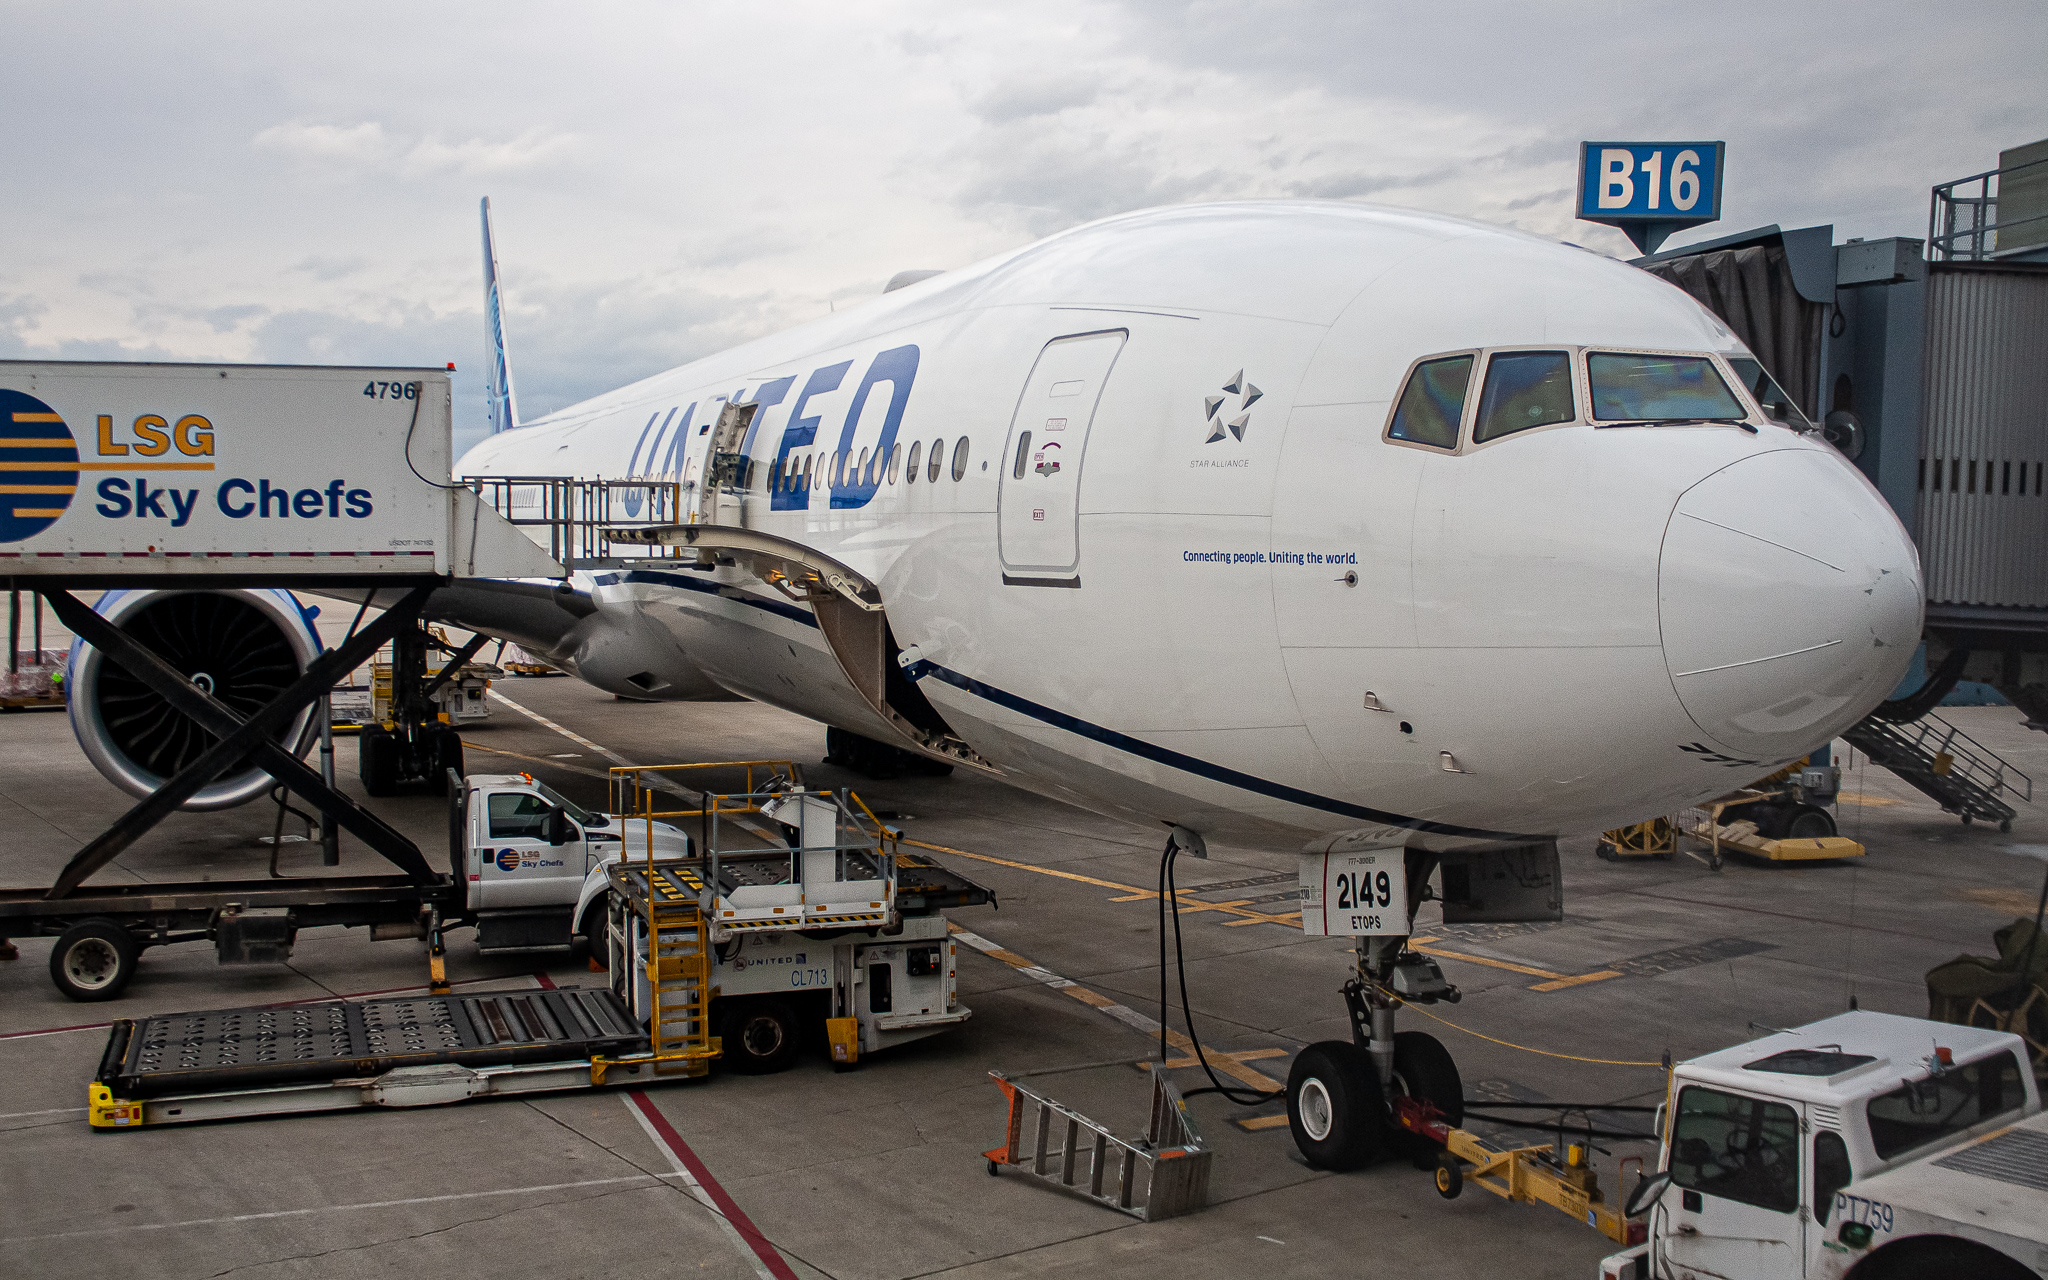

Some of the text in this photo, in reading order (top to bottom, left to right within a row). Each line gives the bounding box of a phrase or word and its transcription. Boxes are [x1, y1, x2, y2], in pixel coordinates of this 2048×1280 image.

[1598, 148, 1700, 211] B16
[363, 381, 416, 400] 4796
[97, 414, 215, 456] LSG
[624, 344, 920, 518] UNTED
[1190, 459, 1249, 468] STAR ALLIANCE
[96, 477, 374, 527] Sky Chefs
[1183, 550, 1358, 565] Connecting people. Uniting the world.
[521, 860, 537, 868] Sky
[1336, 870, 1391, 909] 2149
[1351, 915, 1382, 930] ETOPS
[747, 956, 793, 967] UNITED
[791, 968, 828, 987] CL713
[1836, 1191, 1894, 1233] PT759
